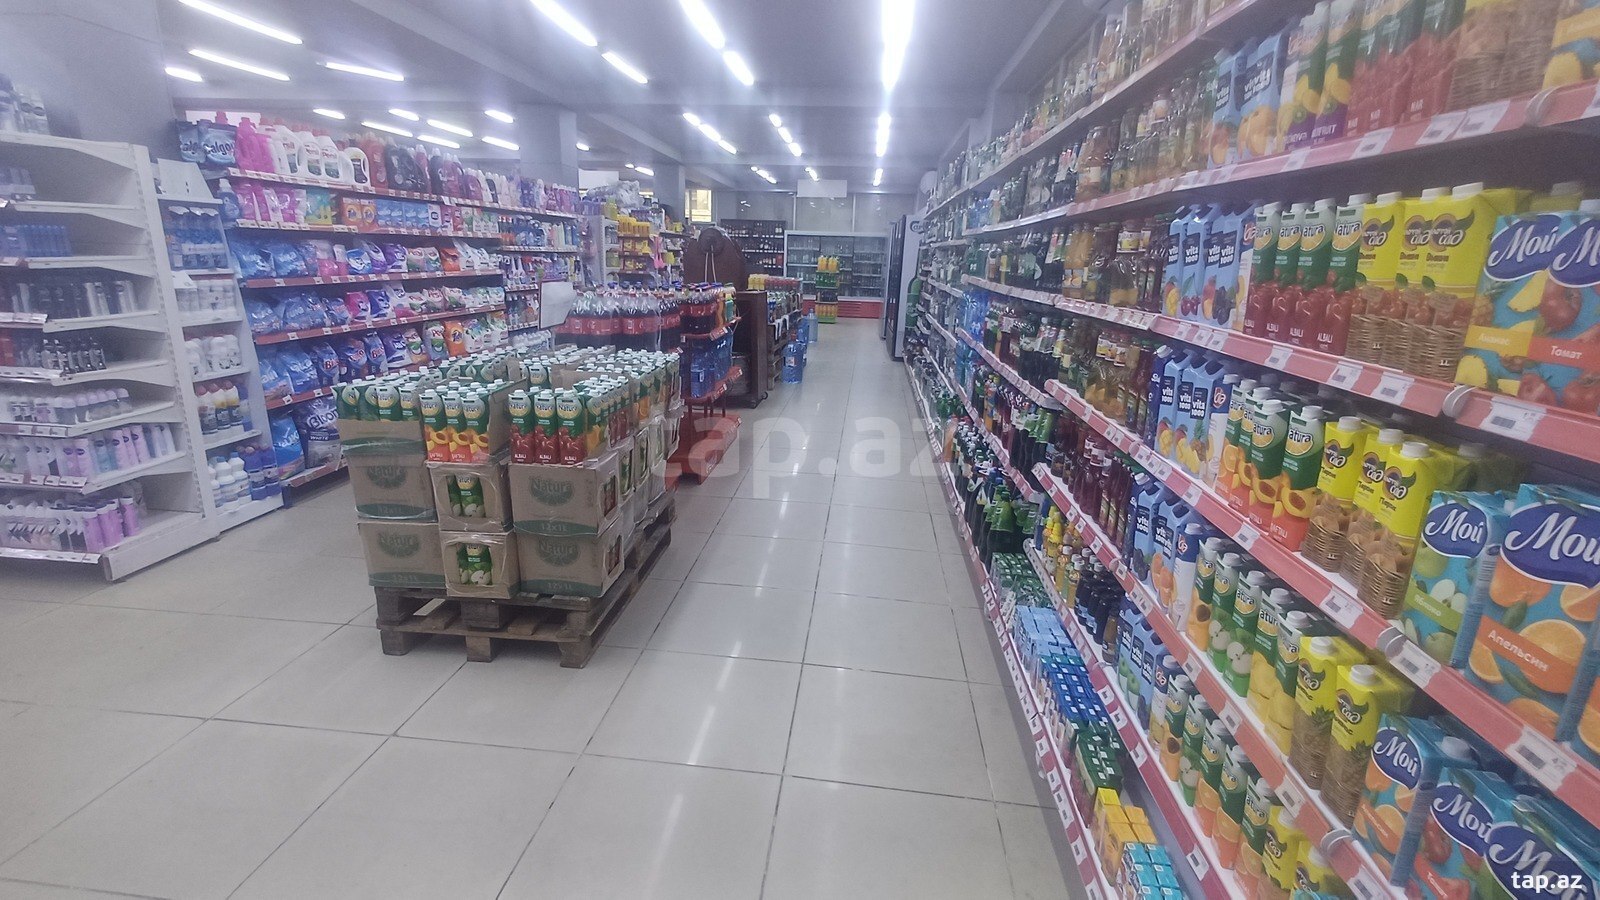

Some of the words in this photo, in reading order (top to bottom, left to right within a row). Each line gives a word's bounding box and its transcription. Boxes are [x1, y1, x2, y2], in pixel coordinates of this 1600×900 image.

[1186, 246, 1199, 256] vita
[1221, 245, 1234, 256] vita
[1487, 224, 1559, 267] Мой
[1317, 332, 1334, 343] ALBALI
[1478, 332, 1511, 346] Ананас
[1550, 345, 1584, 361] Томат
[1162, 386, 1173, 396] vita
[1180, 393, 1191, 402] vita
[1192, 399, 1205, 410] vita
[1191, 409, 1204, 417] 1000
[530, 477, 572, 492] Natura
[1425, 508, 1484, 544] Мой
[1414, 594, 1442, 617] Яблоко
[1488, 629, 1549, 672] Апельсин
[1373, 735, 1418, 778] Мой
[1433, 793, 1494, 843] Мой
